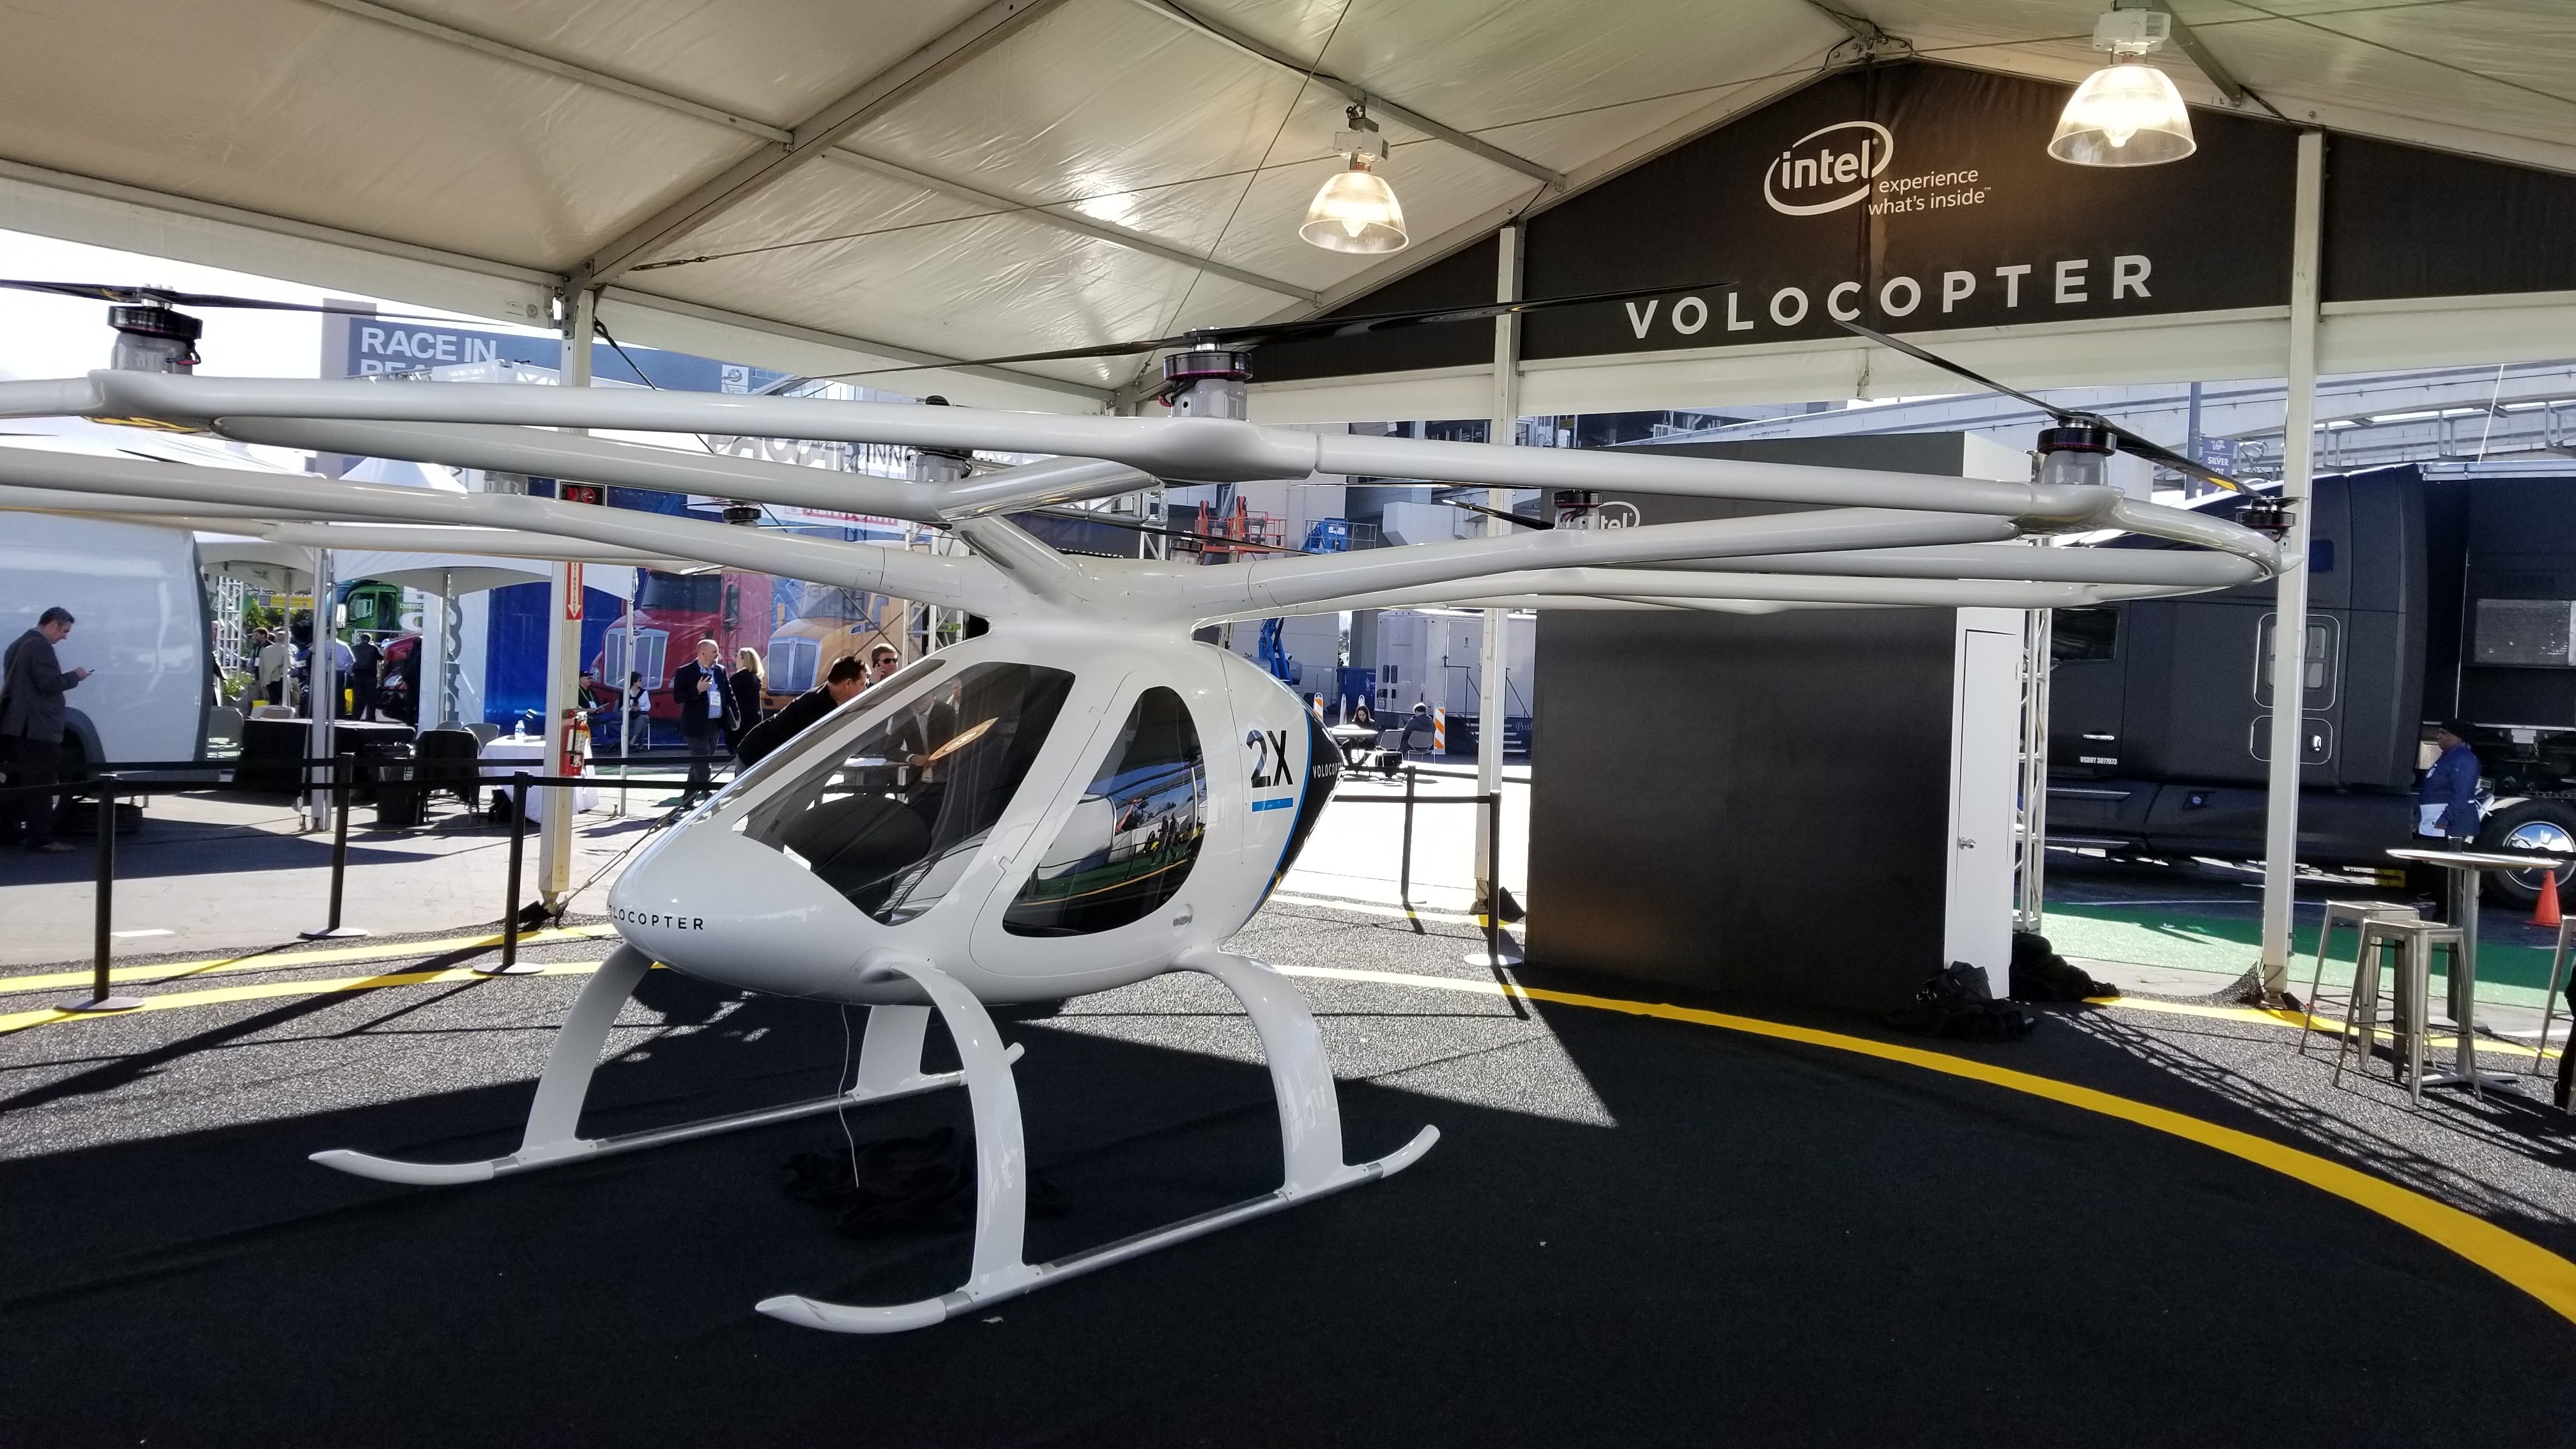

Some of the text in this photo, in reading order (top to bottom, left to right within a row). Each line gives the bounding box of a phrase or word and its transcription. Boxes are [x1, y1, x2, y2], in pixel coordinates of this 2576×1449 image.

[1782, 138, 1870, 190] intel
[1878, 169, 1979, 195] experience
[1867, 194, 1925, 215] what's
[1625, 254, 2152, 339] VOLOCOPTER
[361, 326, 496, 365] RACE IN
[2207, 456, 2230, 466] SILVER
[1600, 512, 1628, 530] tel
[1246, 729, 1294, 788] 2X
[608, 905, 704, 931] OLOCOPTER
